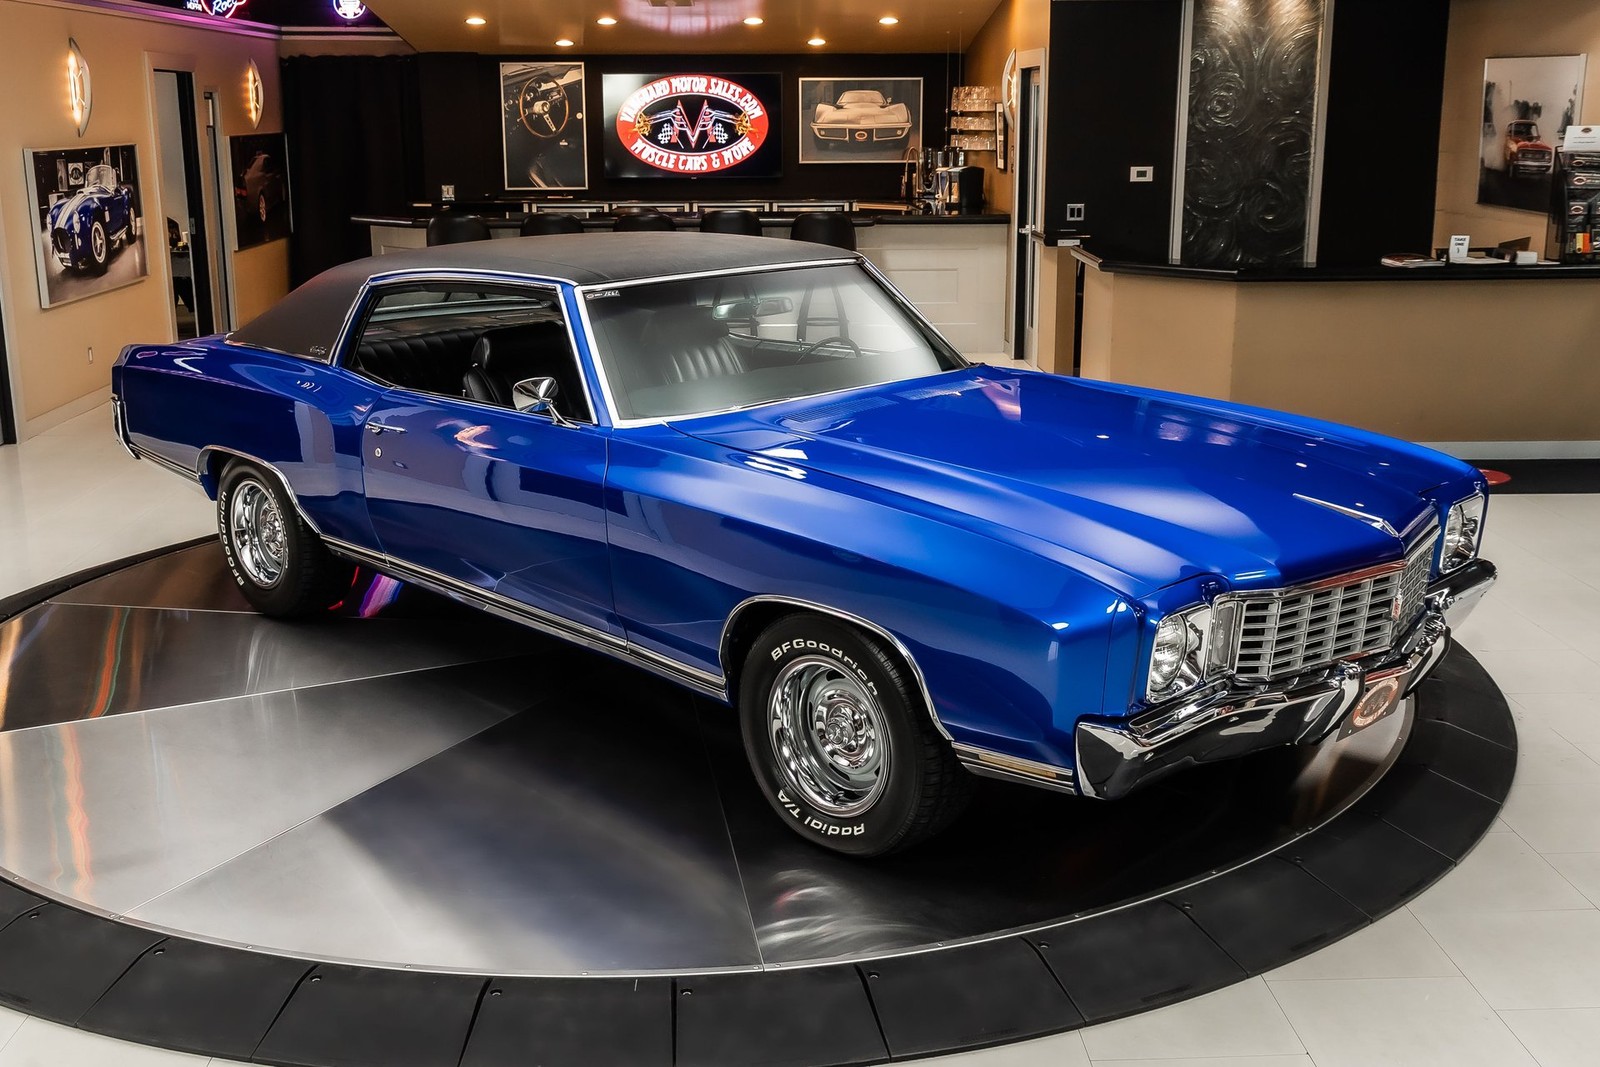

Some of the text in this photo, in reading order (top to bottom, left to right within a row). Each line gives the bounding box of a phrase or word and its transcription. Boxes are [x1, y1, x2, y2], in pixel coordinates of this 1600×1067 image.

[620, 76, 764, 123] VANGUARD MOTOR SALES.COM
[630, 137, 756, 171] MUSCLE CARS & MORE
[770, 638, 879, 696] BFGoodrich
[777, 789, 866, 837] Radial T/A
